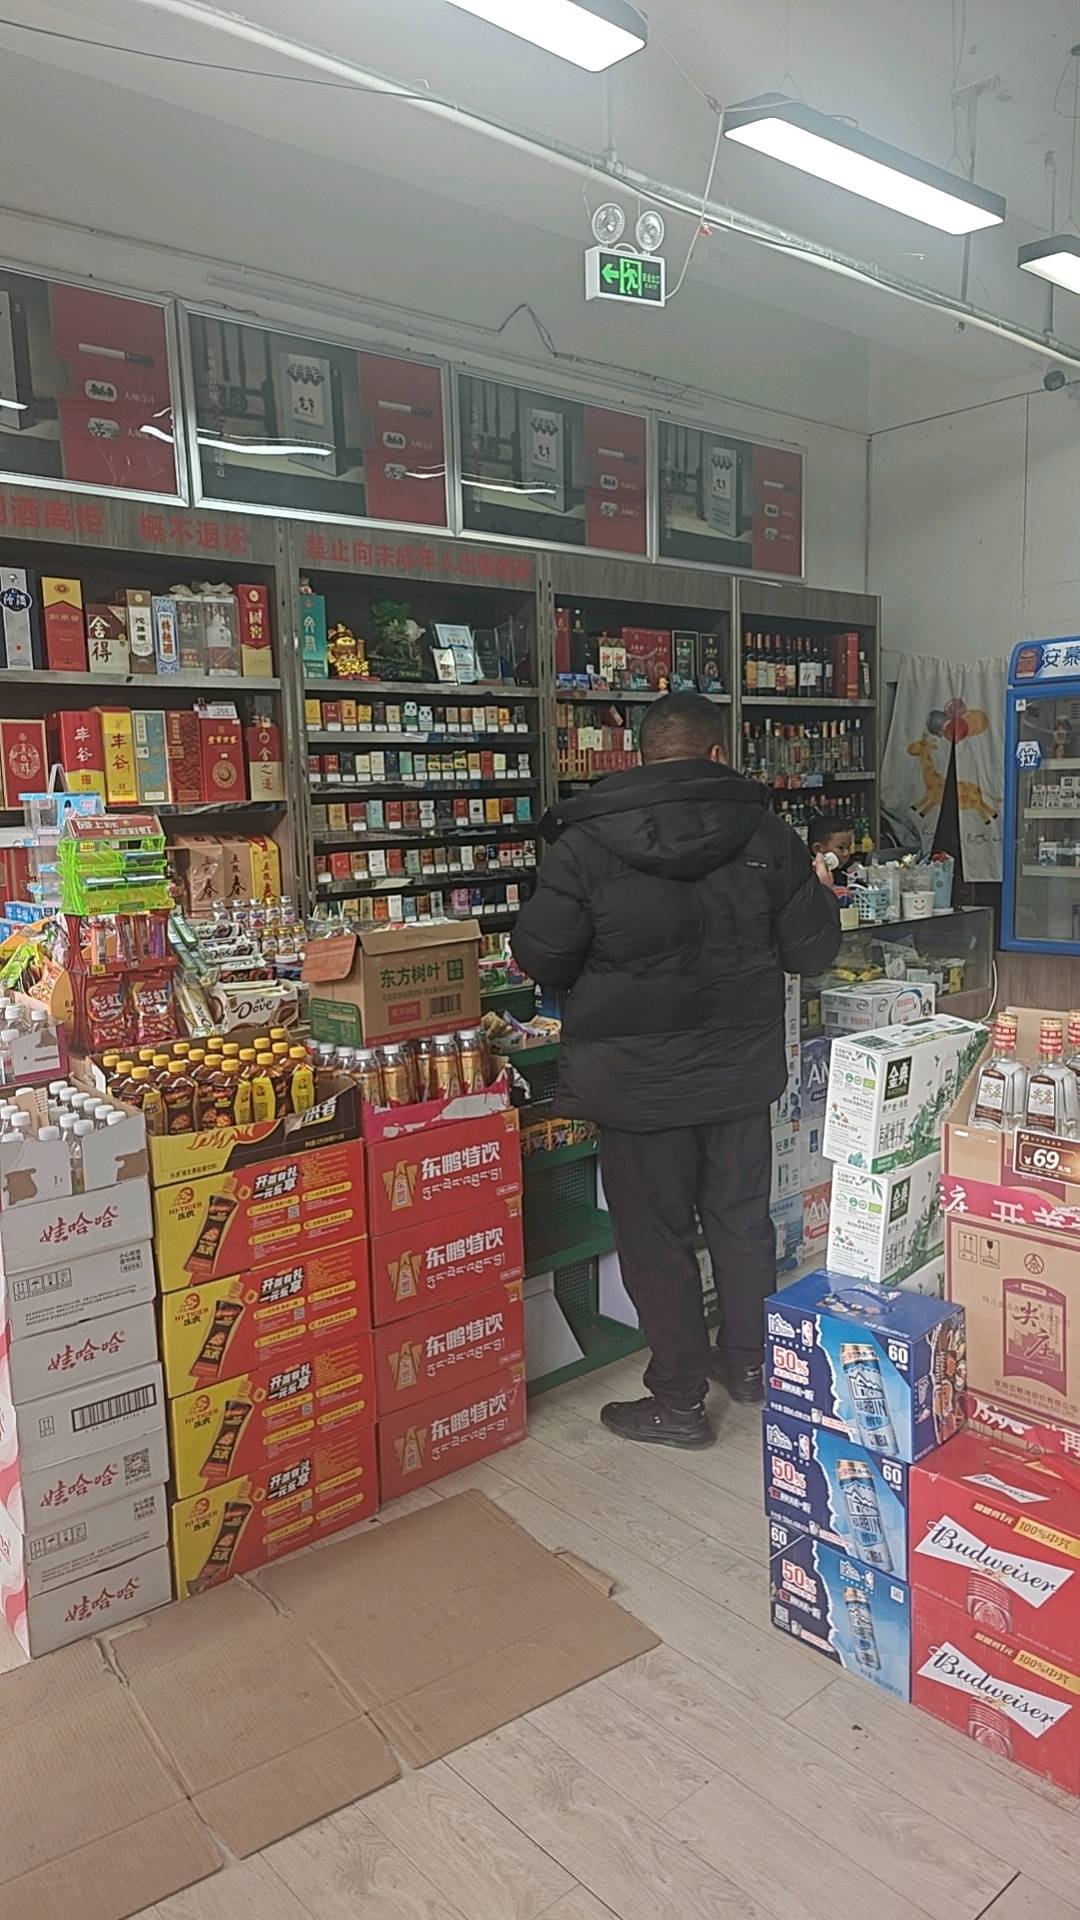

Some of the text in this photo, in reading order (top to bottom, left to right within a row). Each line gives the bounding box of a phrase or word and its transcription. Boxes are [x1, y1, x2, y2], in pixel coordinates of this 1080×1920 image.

[0, 495, 104, 535] 酒离柜
[89, 615, 112, 663] 舍得
[74, 726, 93, 762] 丰谷
[110, 733, 128, 770] 丰谷
[1019, 748, 1037, 767] 拉
[380, 962, 442, 989] 东方树叶
[230, 1000, 275, 1020] Dove
[420, 1141, 501, 1181] 东鹏特饮
[40, 1206, 118, 1244] 娃哈哈
[426, 1227, 505, 1270] 东鹏特饮
[48, 1331, 126, 1371] 娃哈哈
[425, 1313, 504, 1359] 东鹏特饮
[888, 1344, 909, 1365] 60
[773, 1345, 810, 1377] 50%
[431, 1393, 507, 1442] 东鹏特饮
[40, 1463, 119, 1507] 娃哈哈
[772, 1455, 807, 1489] 50%
[882, 1464, 902, 1485] 60
[770, 1526, 788, 1546] 60
[927, 1519, 1058, 1594] Budweiser
[782, 1558, 817, 1596] 50%
[64, 1576, 141, 1623] 娃哈哈
[928, 1645, 1056, 1726] Budweiser
